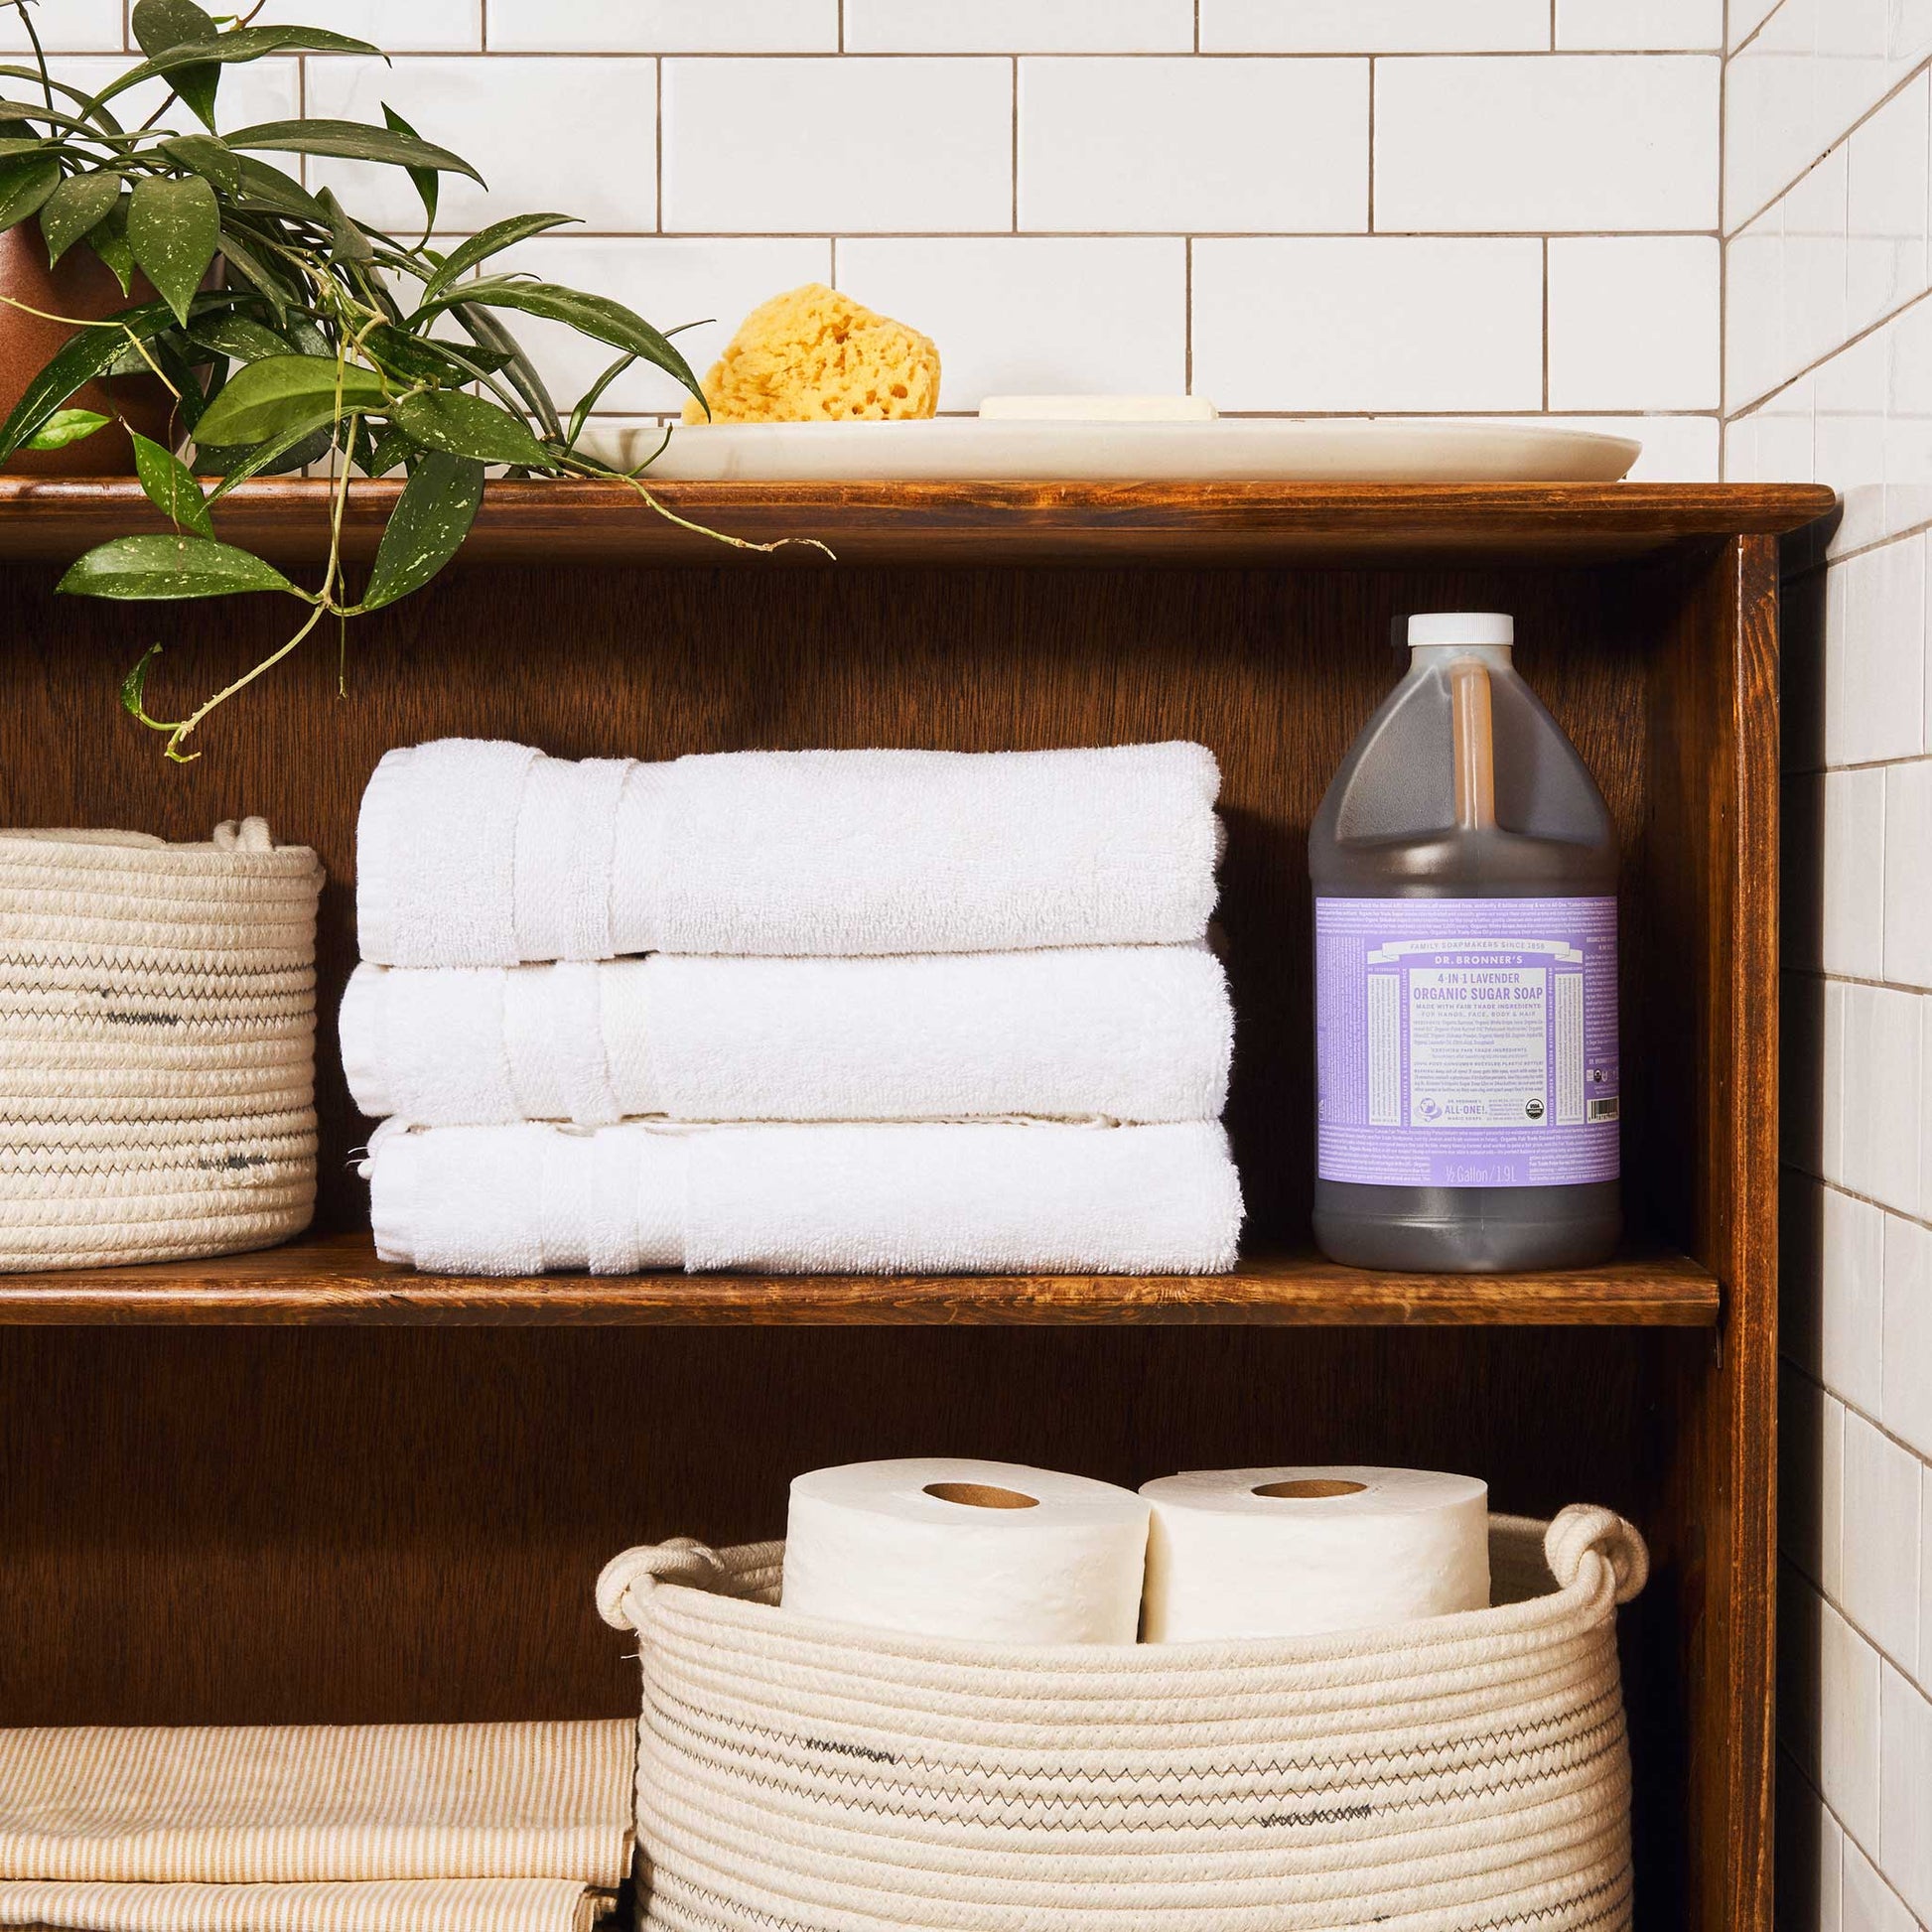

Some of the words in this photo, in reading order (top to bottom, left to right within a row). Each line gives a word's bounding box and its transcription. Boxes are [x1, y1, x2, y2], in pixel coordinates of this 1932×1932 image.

[1435, 955, 1453, 964] DR.
[1456, 955, 1523, 964] BRONNER'S
[1470, 973, 1520, 984] LAVENDER
[1413, 987, 1467, 1001] ORGANIC
[1470, 987, 1510, 1001] SUGAR
[1513, 987, 1544, 1001] SOAP
